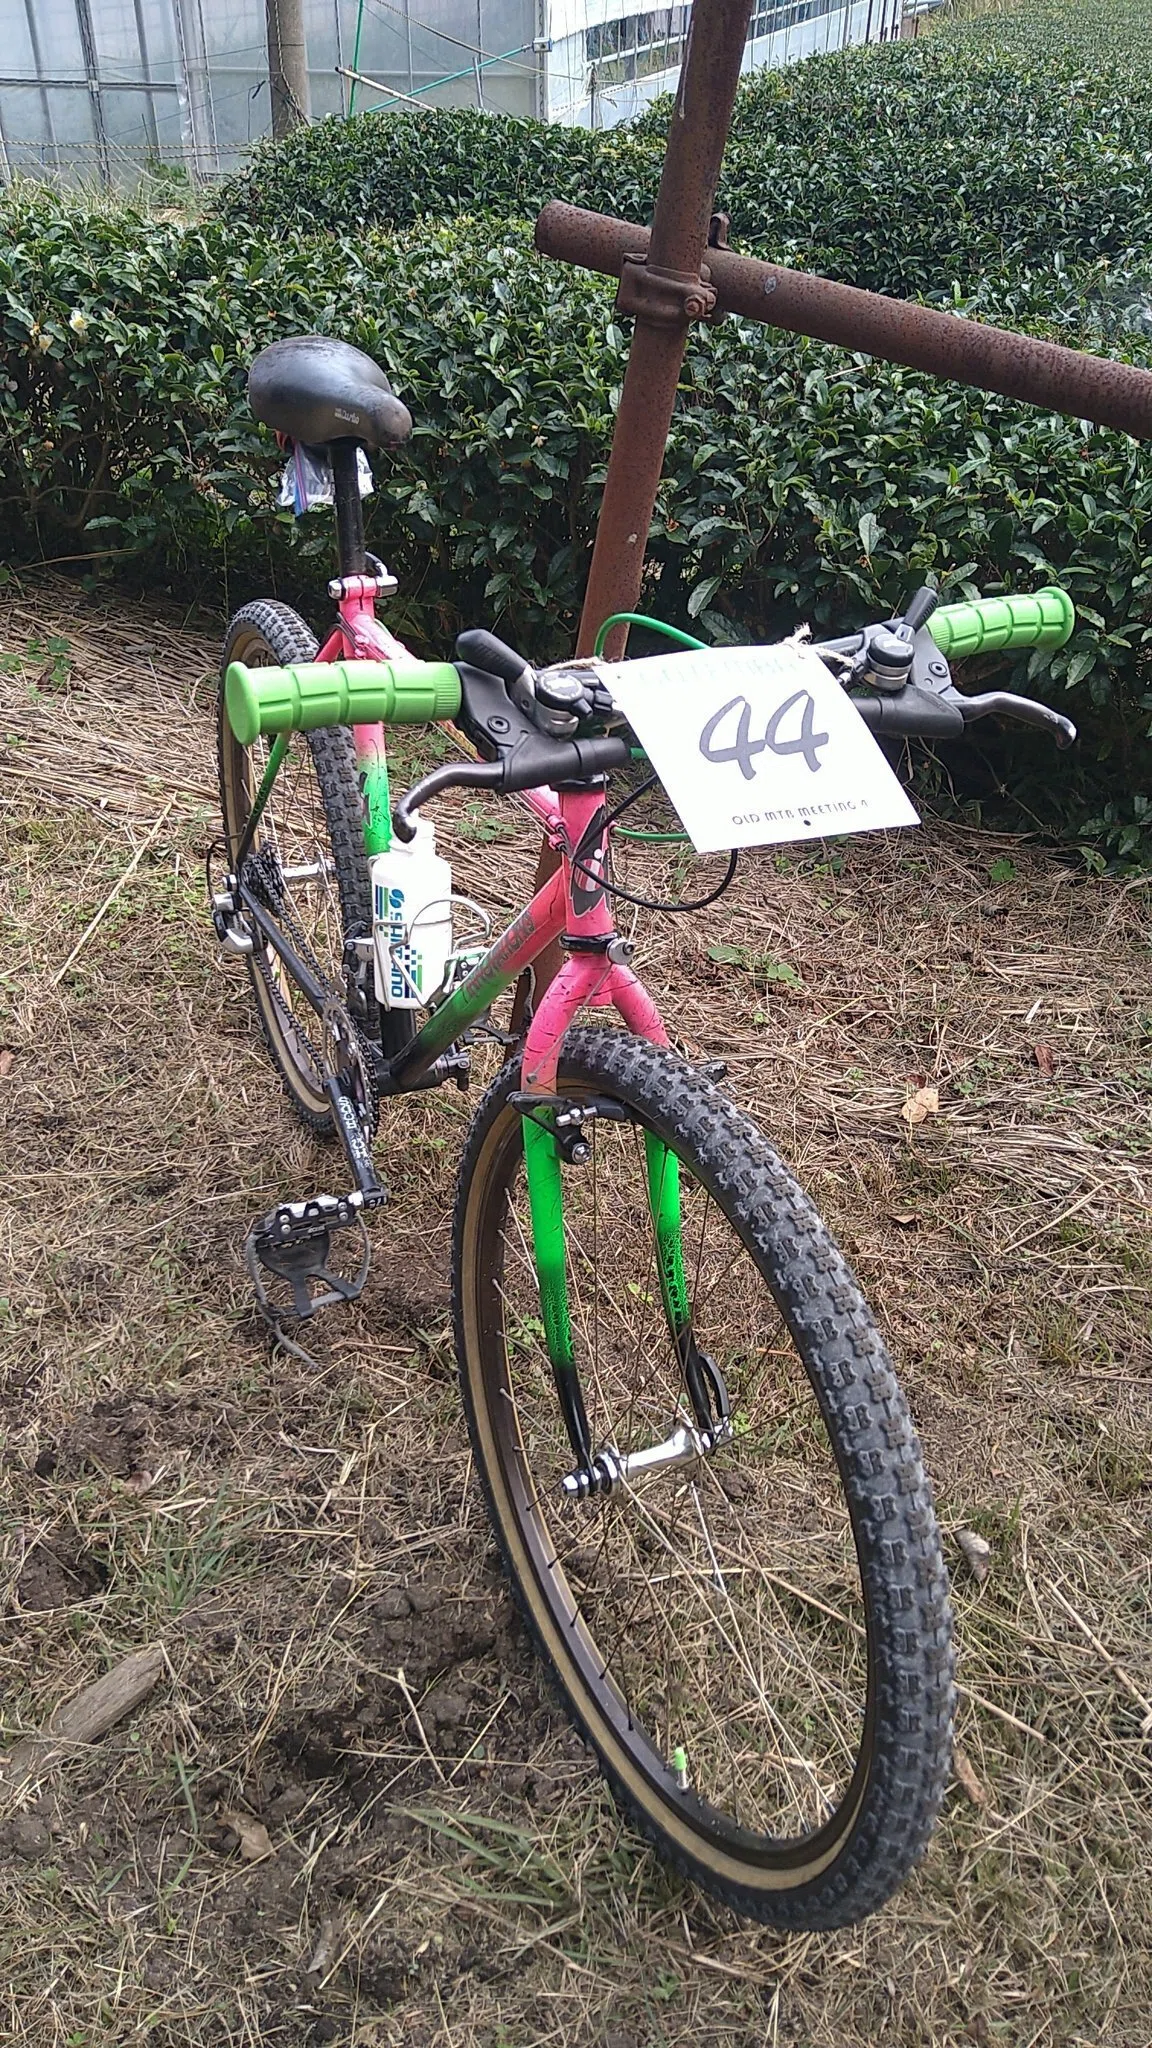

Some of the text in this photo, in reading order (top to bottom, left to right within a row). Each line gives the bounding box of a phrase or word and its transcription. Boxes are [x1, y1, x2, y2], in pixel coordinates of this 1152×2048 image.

[699, 689, 829, 780] 44
[732, 813, 760, 825] OLD
[798, 801, 857, 817] MEETING
